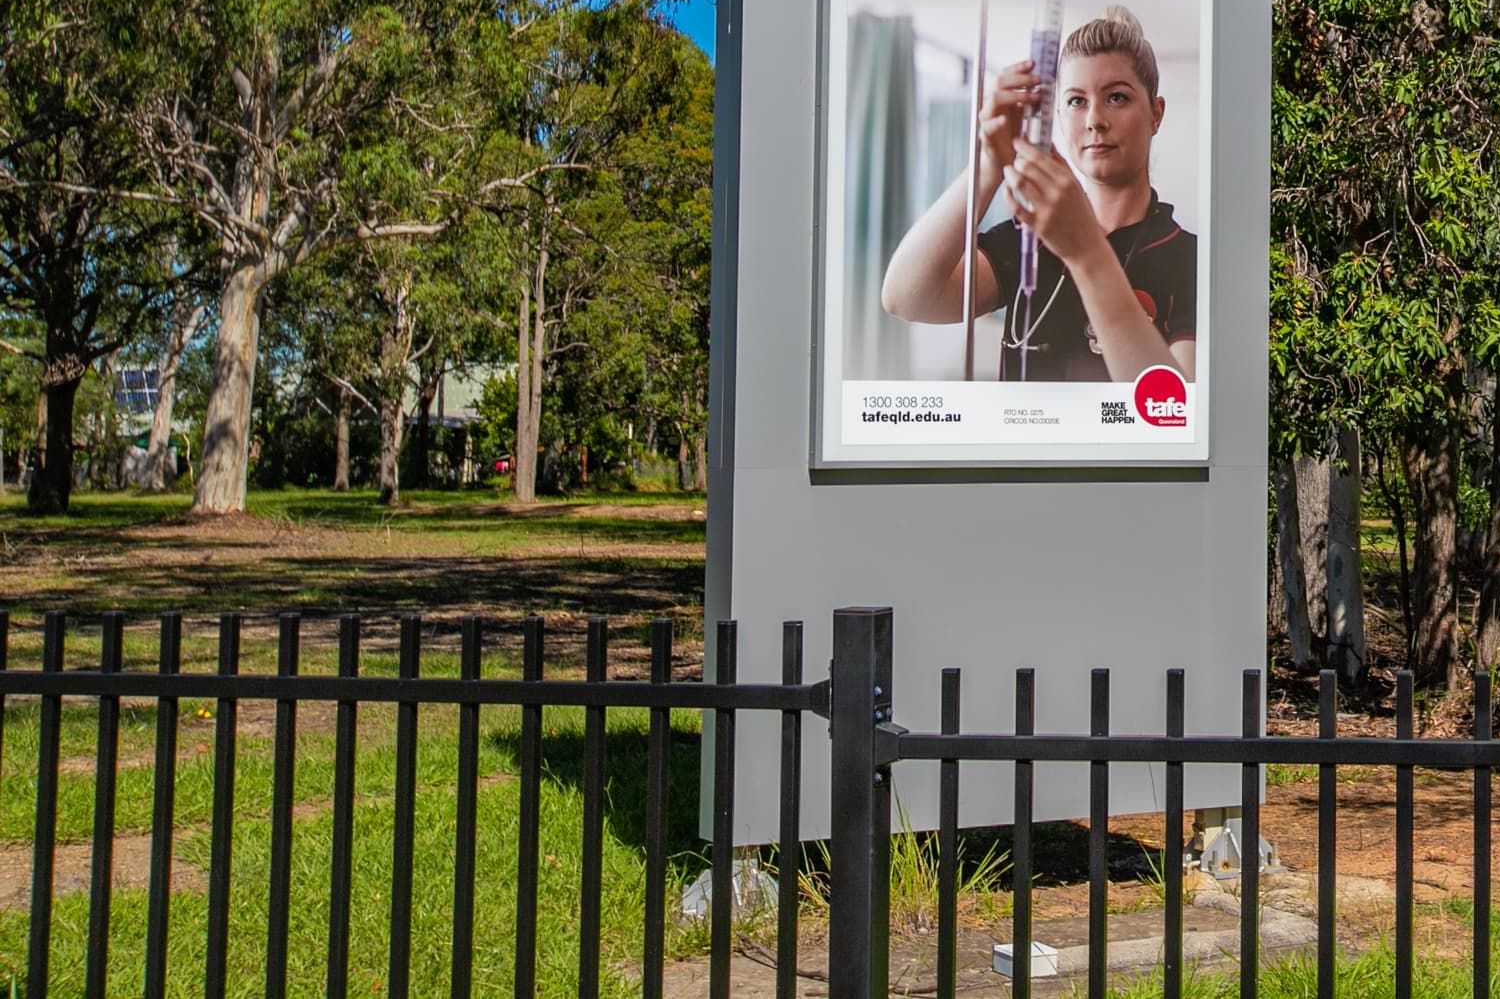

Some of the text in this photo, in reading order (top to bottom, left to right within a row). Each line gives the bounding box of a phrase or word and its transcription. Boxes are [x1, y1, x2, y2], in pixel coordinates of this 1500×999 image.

[863, 397, 943, 408] 1300 308 233
[1145, 397, 1186, 417] tafe
[862, 411, 961, 424] tafeqld.edu.au
[1101, 409, 1128, 417] GREAT
[1101, 416, 1135, 424] HAPPEN
